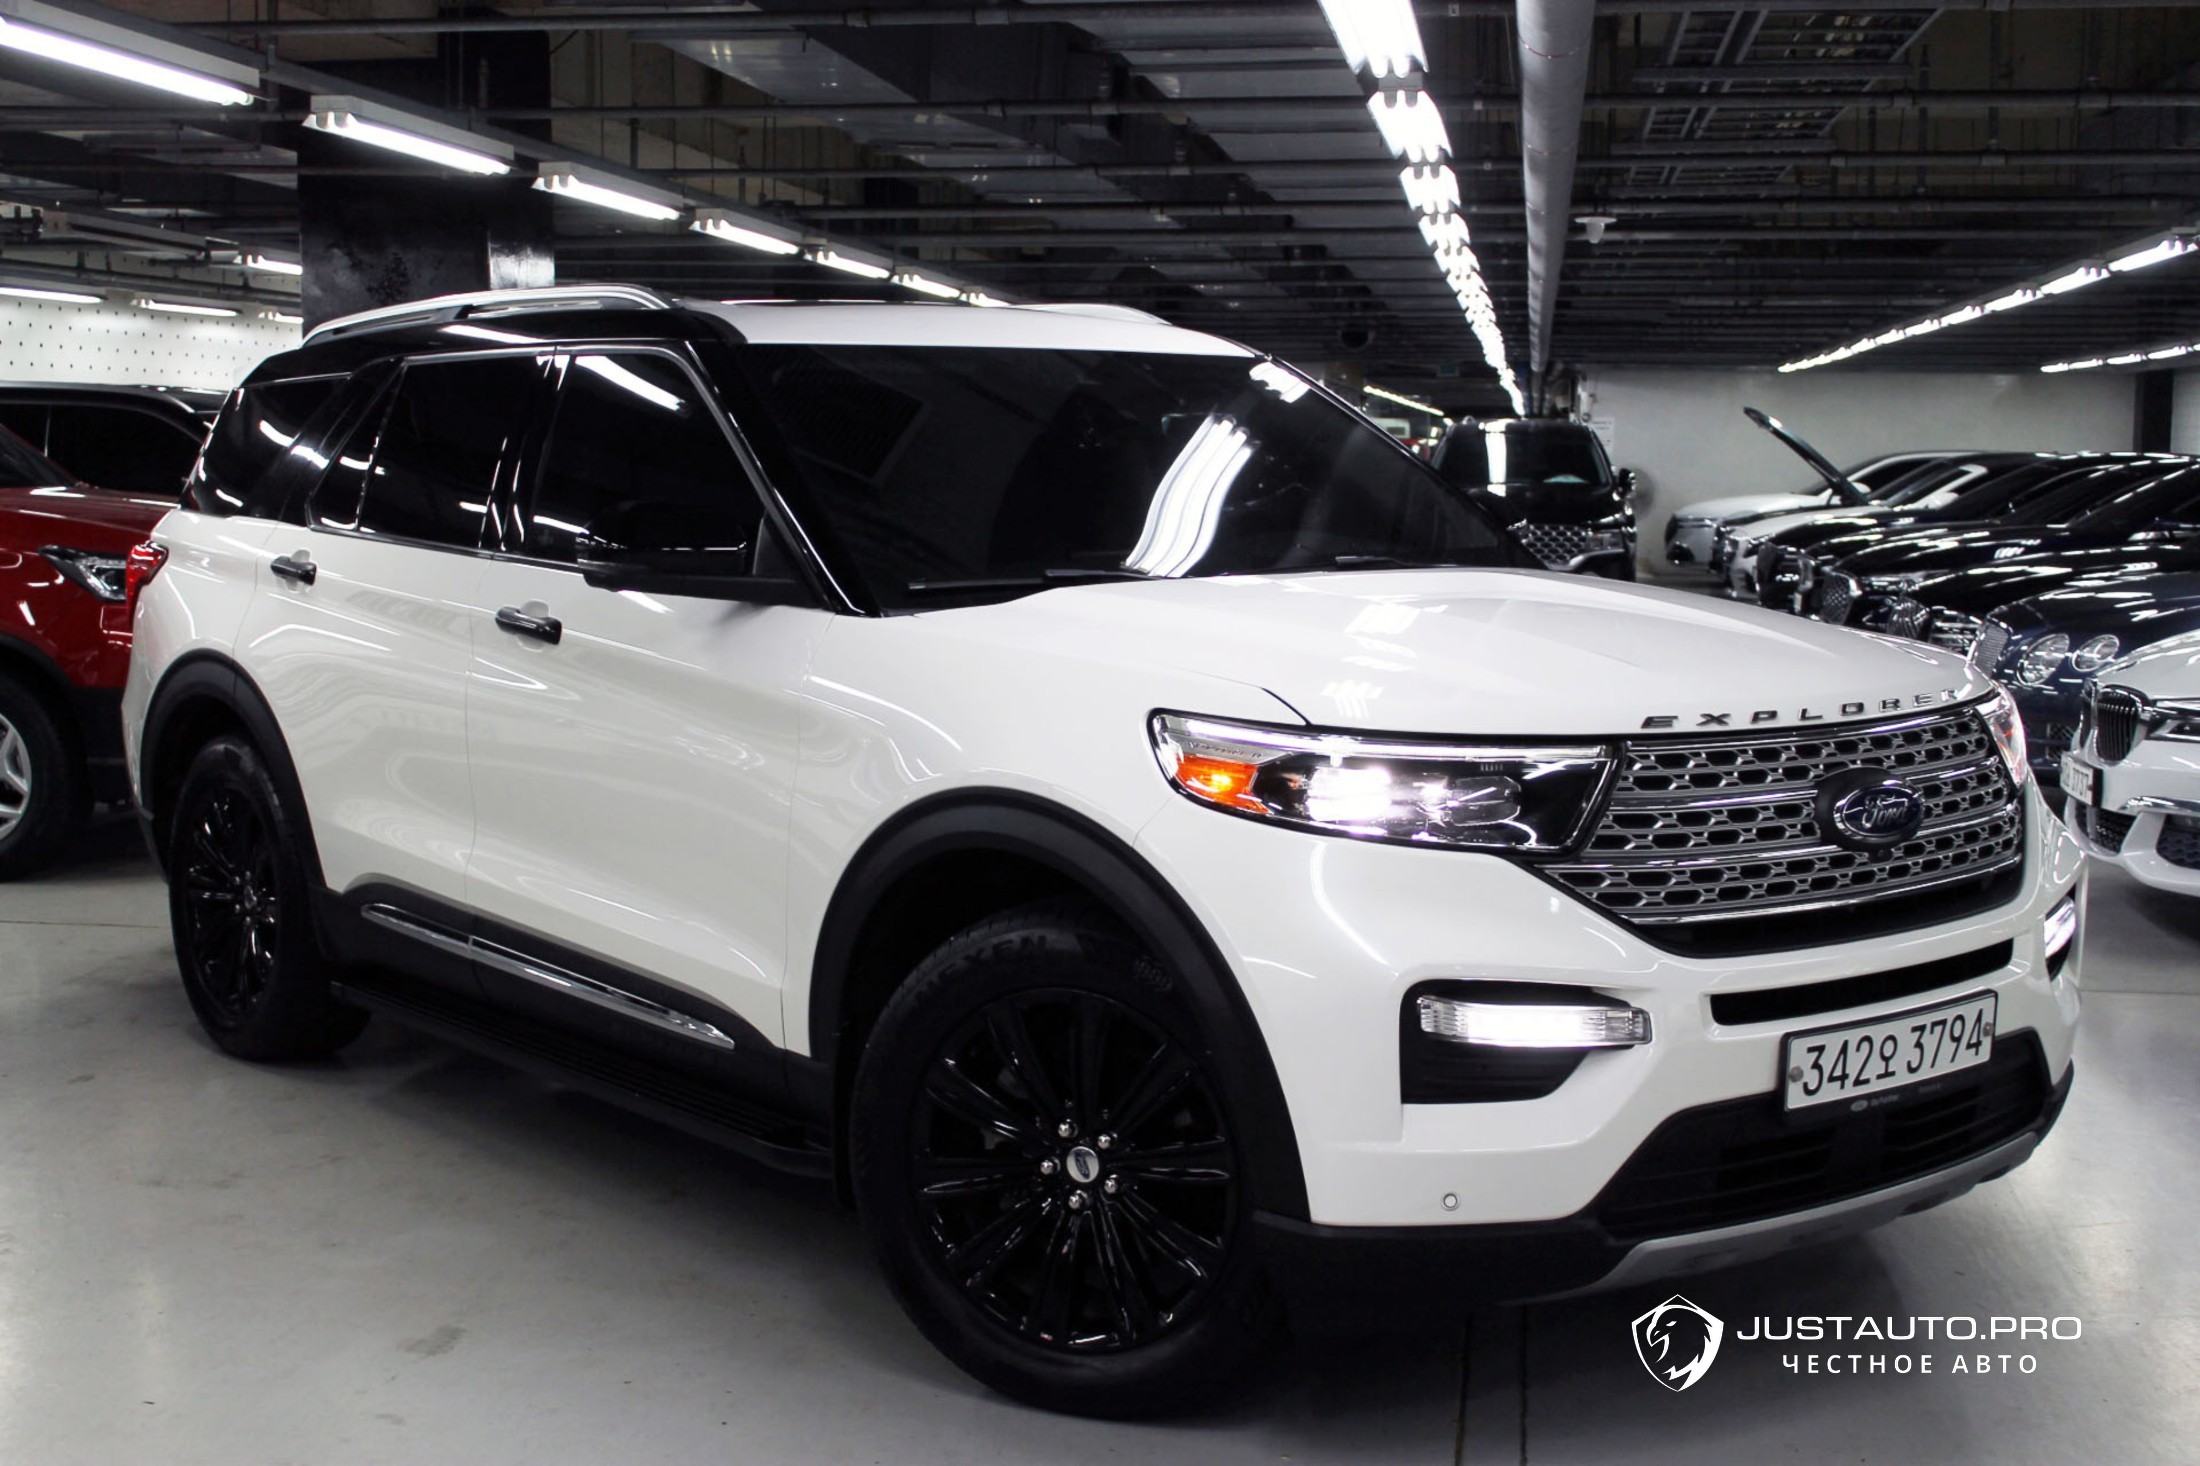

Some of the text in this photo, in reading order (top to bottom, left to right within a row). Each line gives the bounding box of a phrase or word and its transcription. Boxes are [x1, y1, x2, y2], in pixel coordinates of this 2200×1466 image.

[1641, 688, 1957, 729] EXPLORER
[1862, 794, 1909, 829] Ford
[1802, 1008, 1983, 1096] 342오 3794
